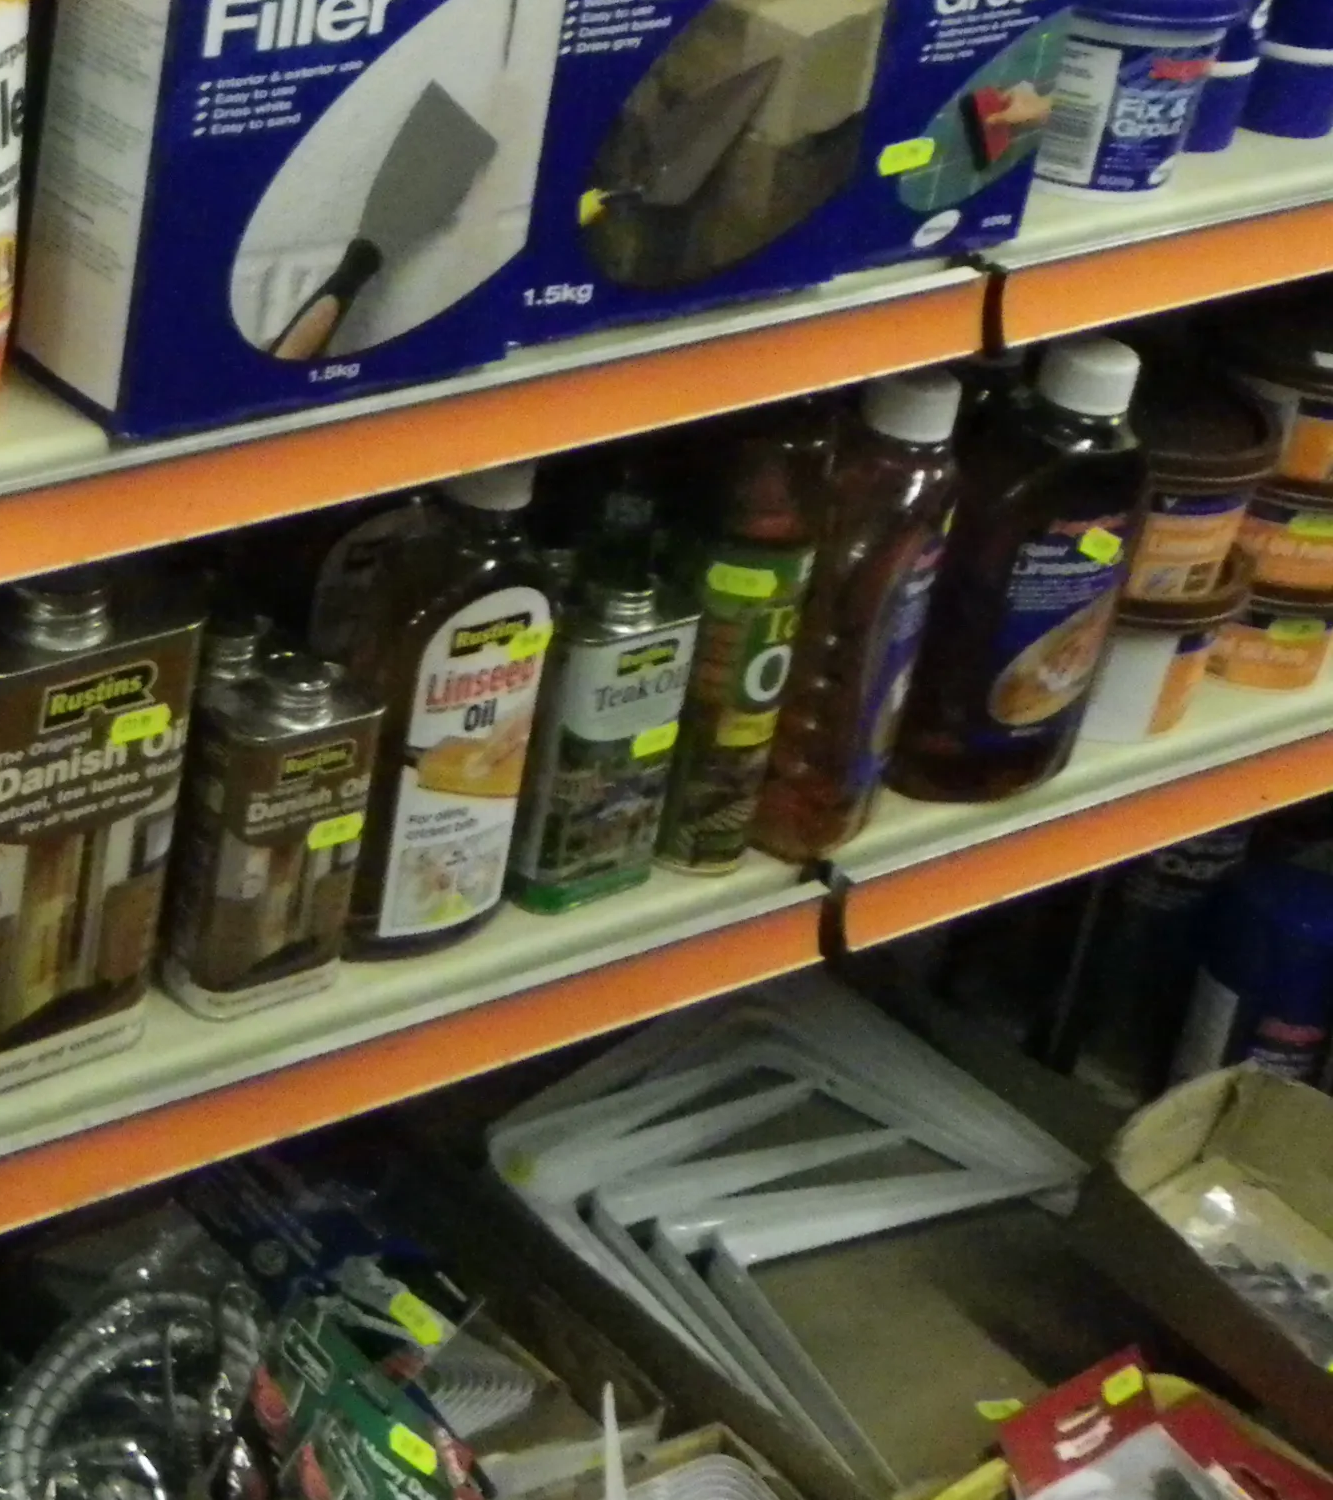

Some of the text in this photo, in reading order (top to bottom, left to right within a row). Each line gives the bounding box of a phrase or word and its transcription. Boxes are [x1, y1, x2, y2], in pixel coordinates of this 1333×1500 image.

[214, 91, 250, 106] Easy
[253, 88, 268, 100] to
[210, 121, 246, 137] Easy
[249, 118, 264, 130] to
[522, 280, 594, 308] 1.5kg
[49, 675, 143, 717] Rustins
[593, 666, 691, 712] Teak Oil
[463, 699, 497, 732] Oil
[141, 717, 188, 758] Oil
